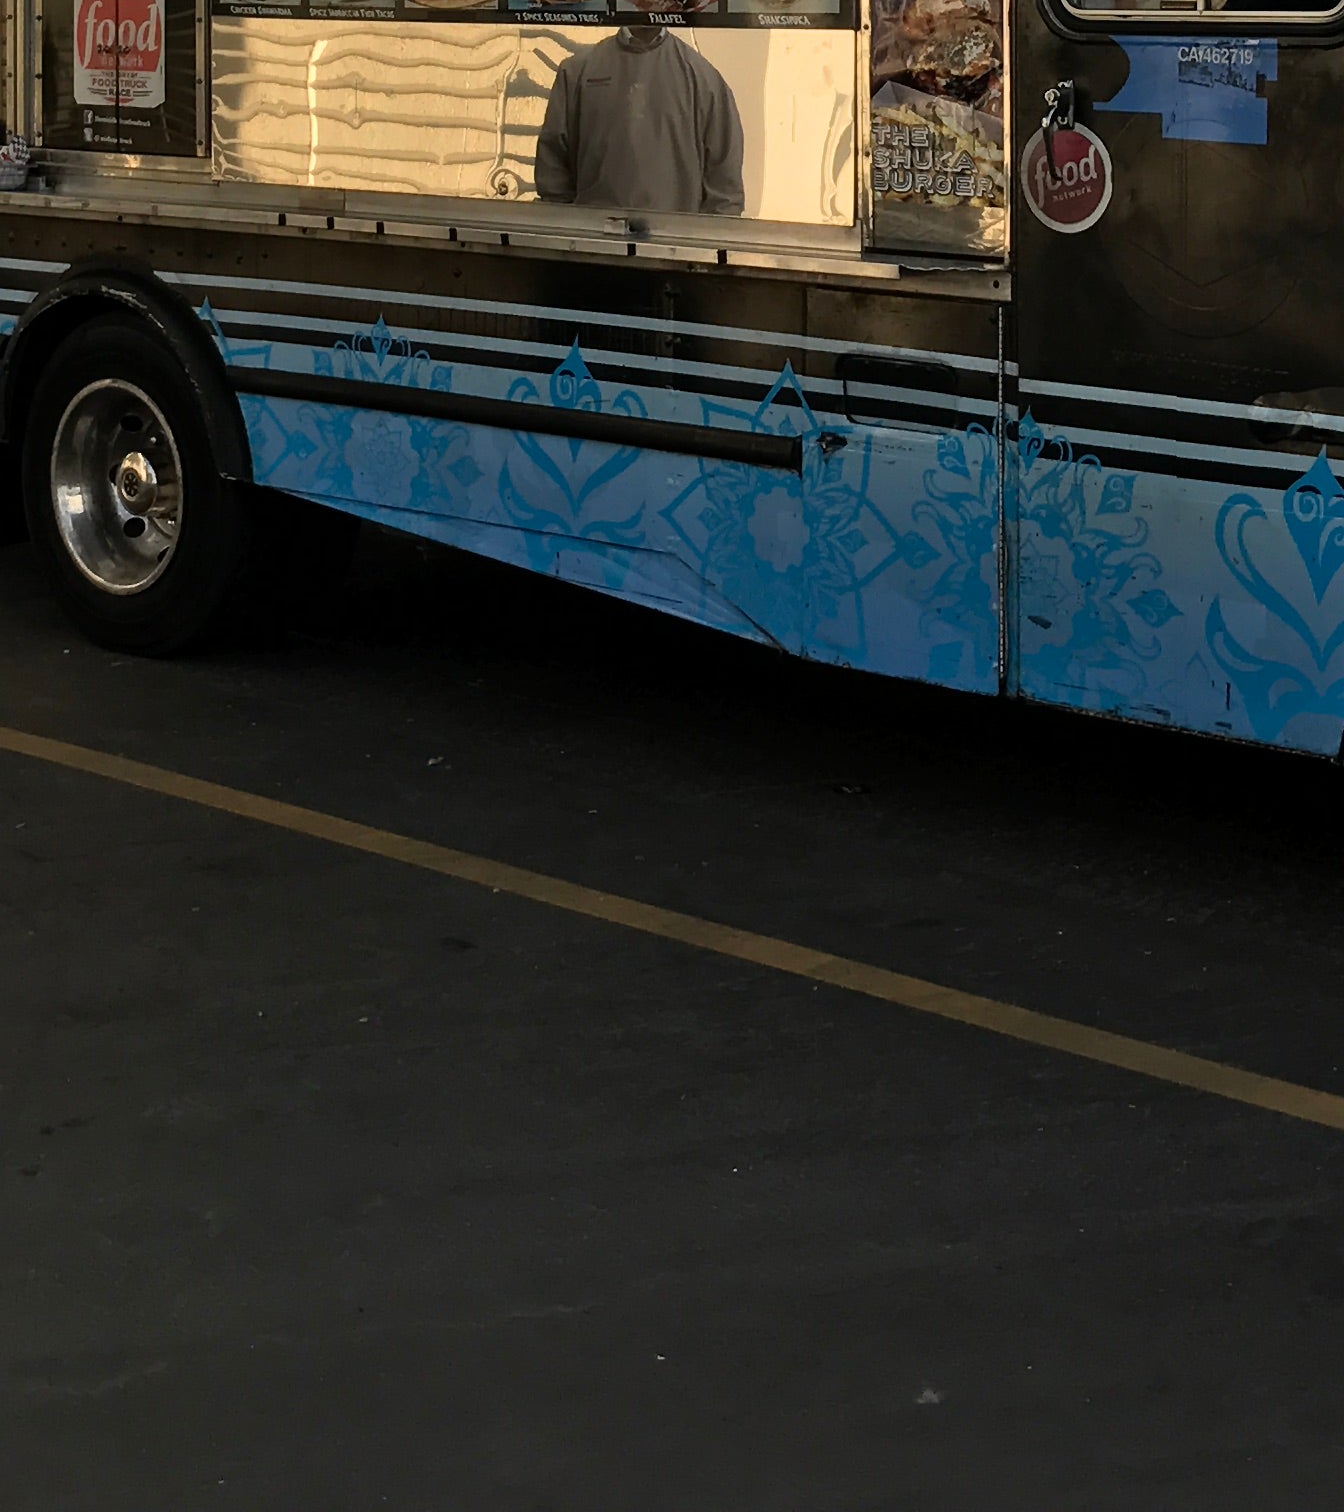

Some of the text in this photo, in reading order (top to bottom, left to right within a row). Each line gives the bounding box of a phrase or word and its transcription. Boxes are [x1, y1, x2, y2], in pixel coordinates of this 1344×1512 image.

[578, 13, 600, 23] FRIES
[649, 12, 687, 24] FALAFEL
[757, 14, 811, 26] SHAKSHUKA
[82, 0, 159, 69] food
[92, 78, 148, 89] FOOD TRUCK
[872, 123, 930, 148] THE
[872, 148, 979, 175] SHUKA
[872, 168, 996, 199] BURGER
[1034, 144, 1098, 208] food
